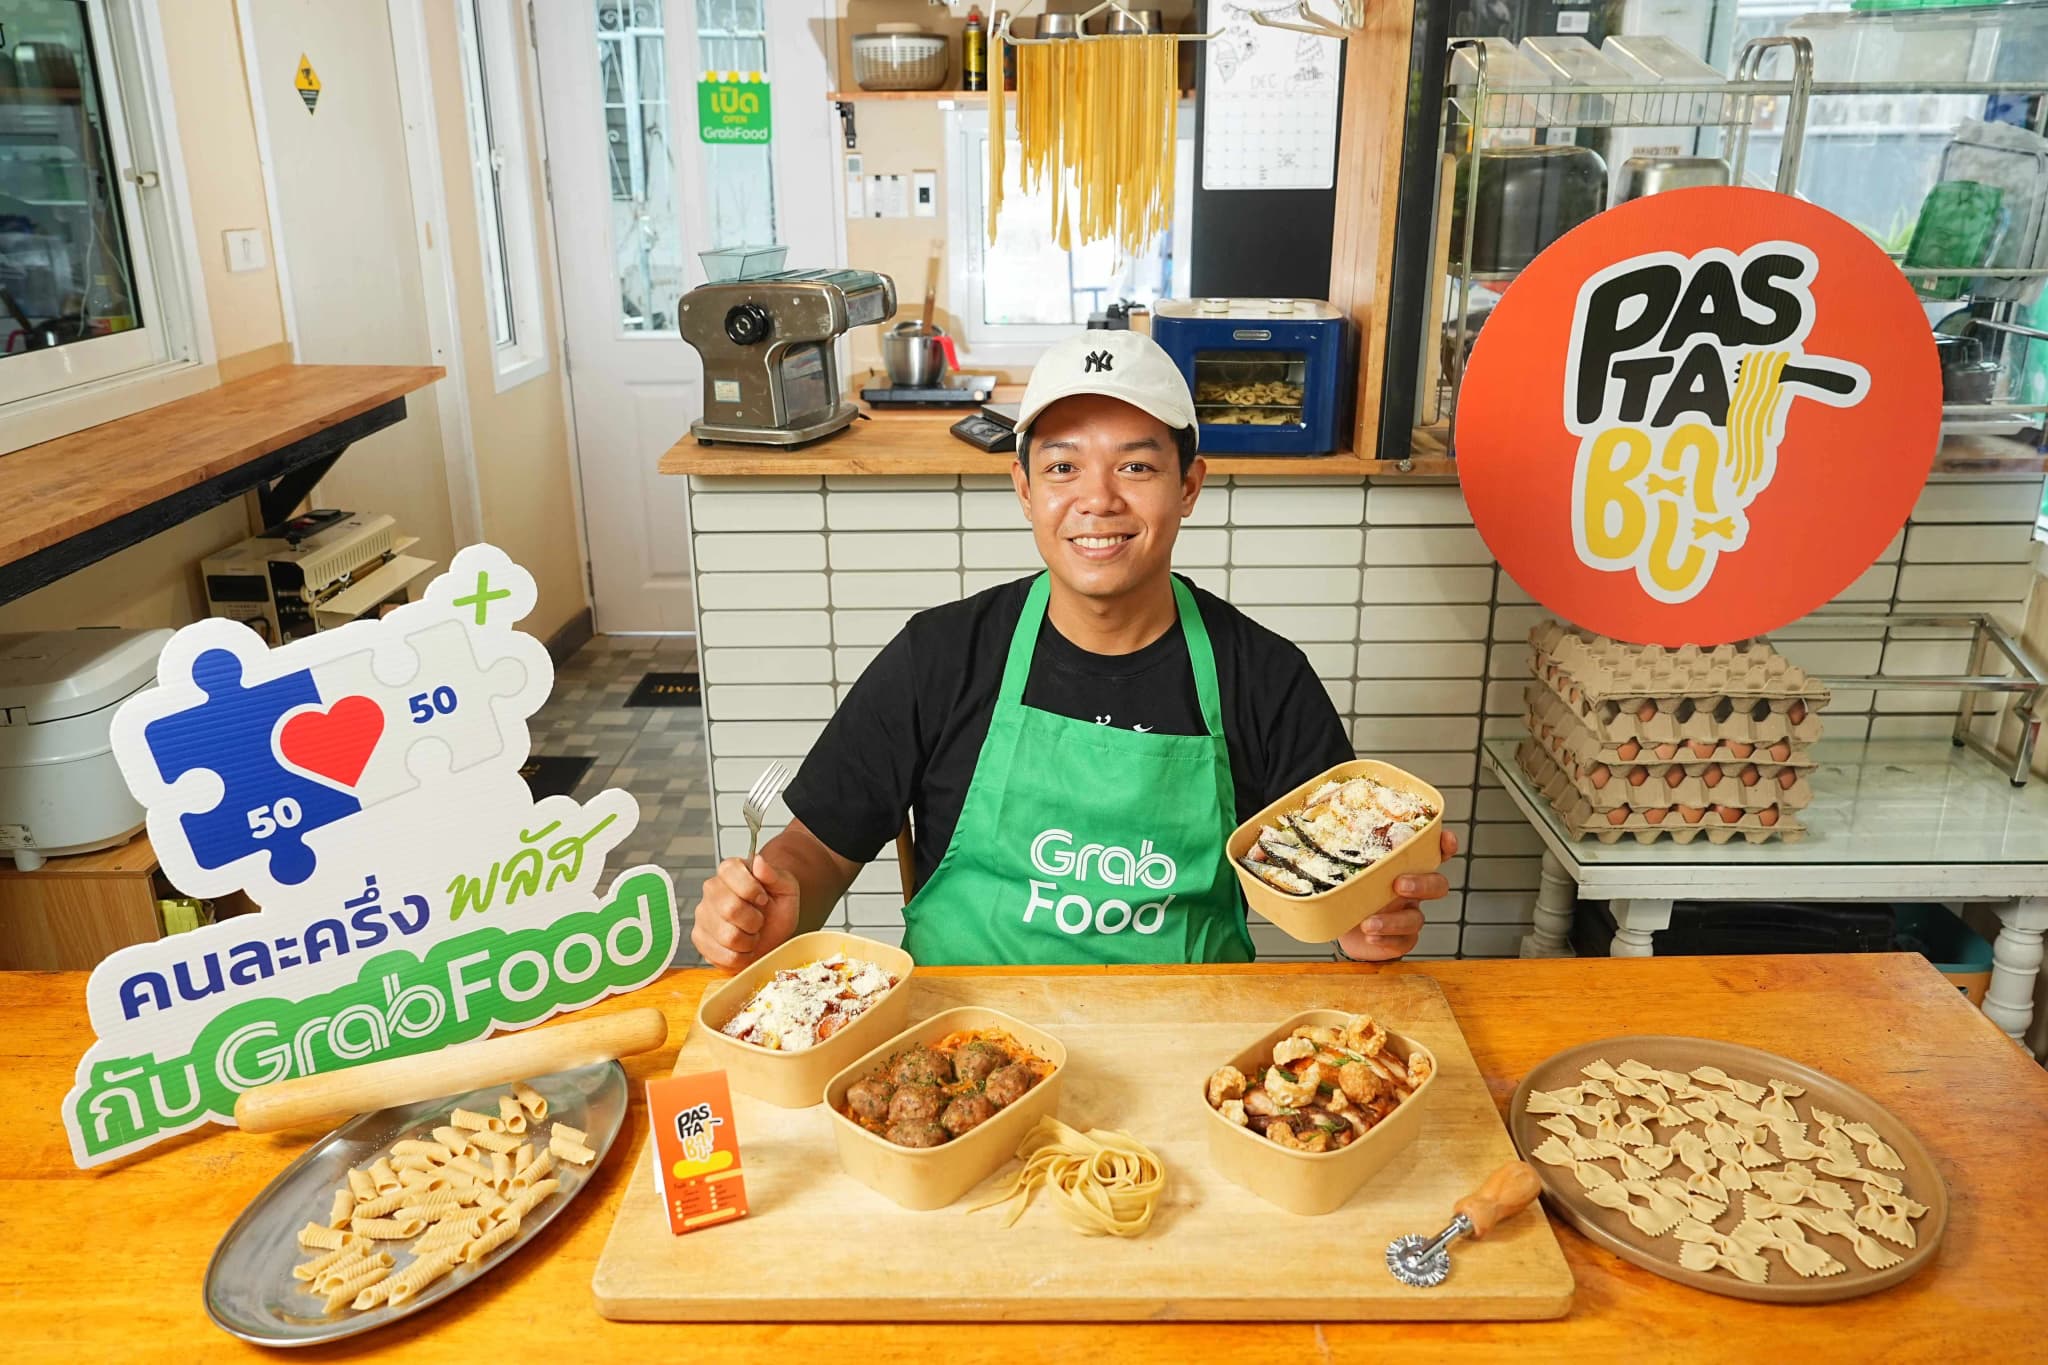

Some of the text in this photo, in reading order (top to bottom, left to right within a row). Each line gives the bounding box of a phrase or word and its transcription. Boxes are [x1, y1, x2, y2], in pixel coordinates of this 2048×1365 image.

[711, 86, 759, 113] เปิด
[722, 115, 748, 124] OPEN
[703, 126, 768, 140] GrabFood
[1577, 254, 1805, 424] PAS
[1084, 349, 1114, 373] NY
[1611, 343, 1730, 428] TA
[408, 685, 458, 724] 50
[246, 796, 303, 839] 50
[1030, 828, 1177, 889] Grab
[119, 813, 618, 1021] คนละครึ่ง พลัส
[1022, 879, 1177, 935] Food
[89, 894, 654, 1142] กับ GrabFood
[677, 1105, 710, 1139] PAS
